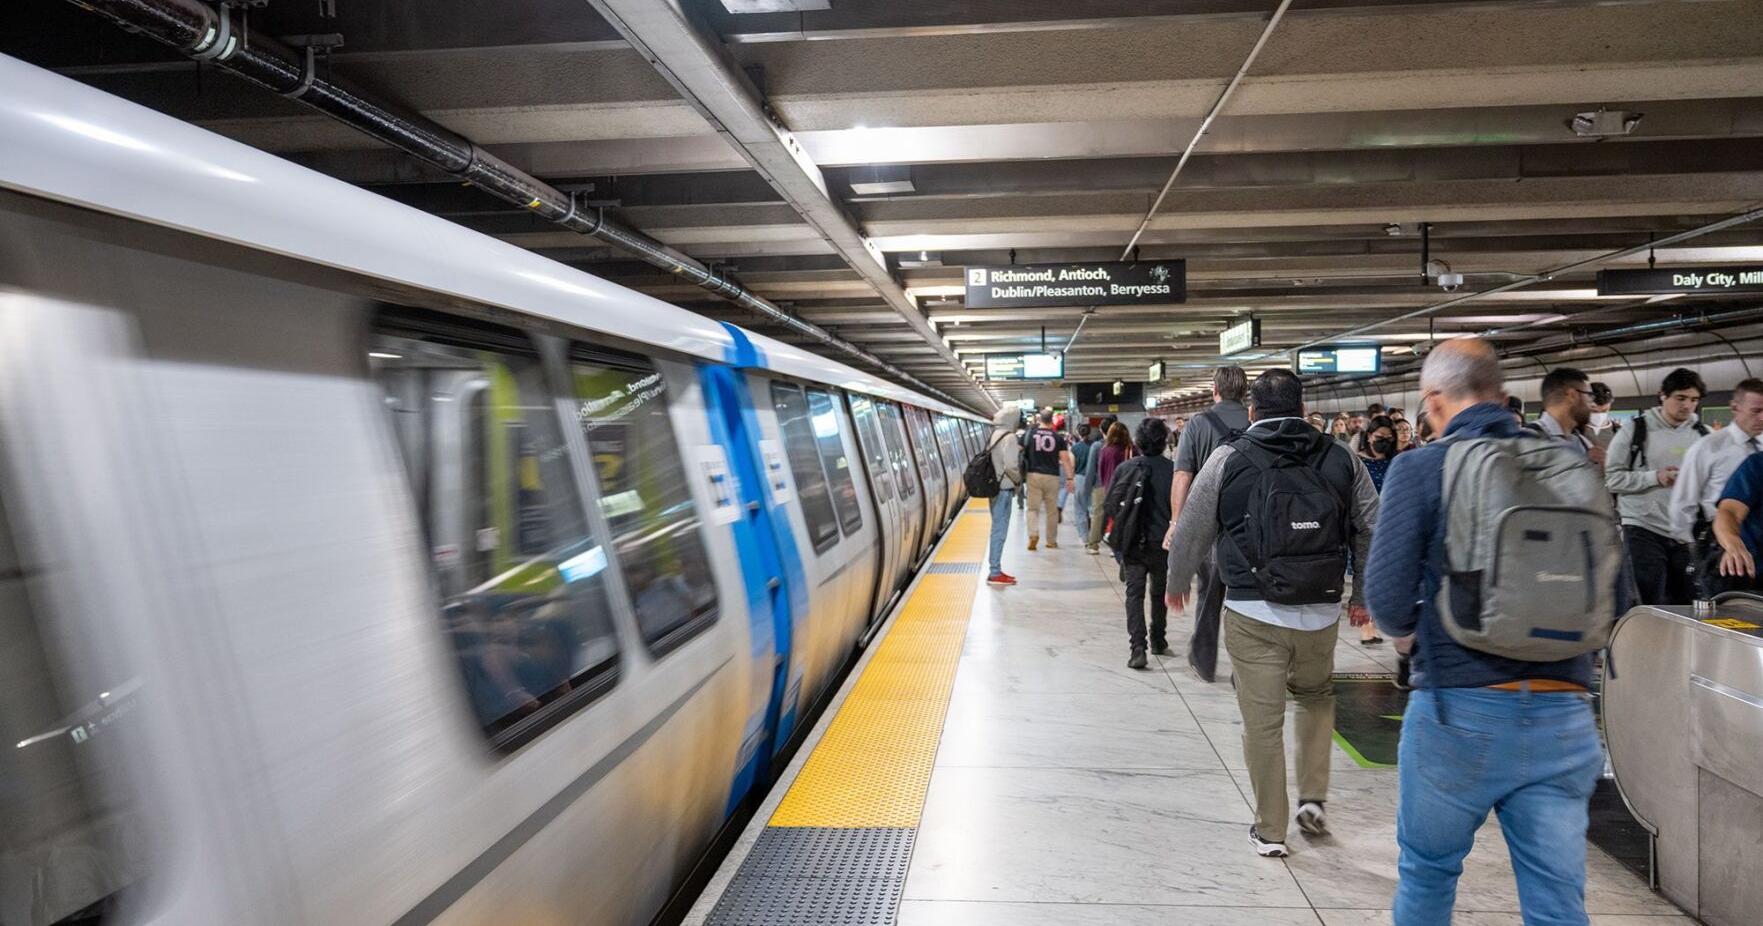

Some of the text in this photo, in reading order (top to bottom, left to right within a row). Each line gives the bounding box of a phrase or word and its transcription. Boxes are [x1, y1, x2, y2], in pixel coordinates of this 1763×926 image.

[974, 267, 1111, 284] 2 Richmond, Antioch,
[1673, 272, 1704, 288] Daly
[1706, 272, 1736, 287] City,
[991, 283, 1170, 298] Dublin/Pleasanton, Berryessa
[1033, 434, 1056, 452] 10
